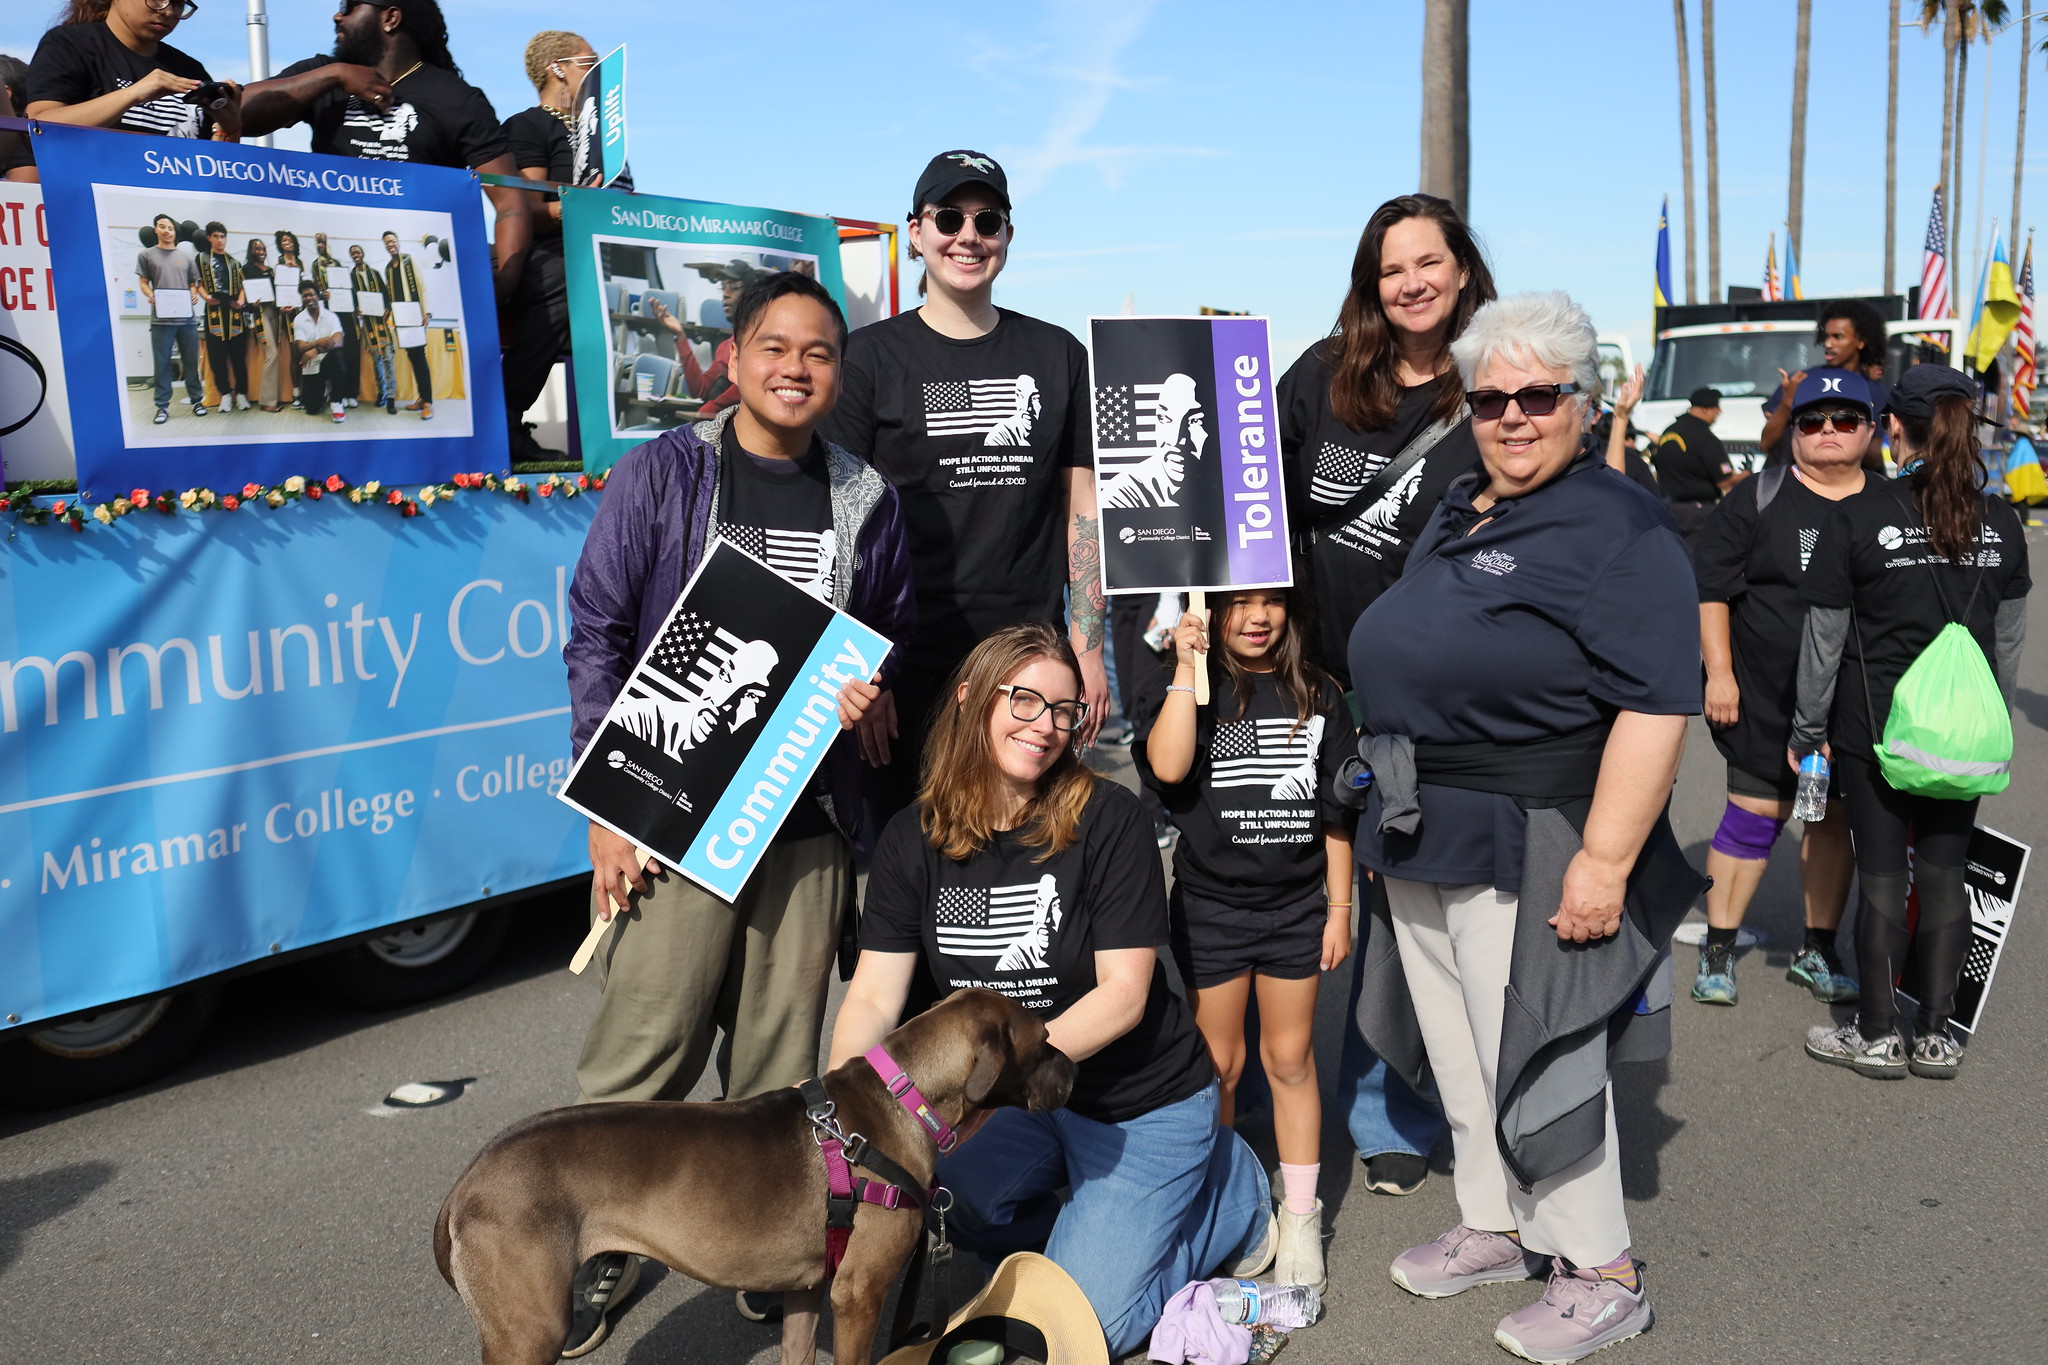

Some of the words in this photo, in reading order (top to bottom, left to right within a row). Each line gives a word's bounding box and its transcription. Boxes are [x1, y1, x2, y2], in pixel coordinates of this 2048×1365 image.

[604, 84, 623, 147] Uplift
[143, 150, 193, 176] SAN
[194, 154, 265, 183] DIEGO
[268, 161, 321, 189] MESA
[321, 169, 404, 197] COLLEGE
[611, 205, 642, 228] SAN
[643, 211, 689, 231] DIEGO
[690, 215, 762, 236] MIRAMAR
[762, 220, 804, 242] COLLEGE
[939, 457, 960, 466] HOPE
[961, 456, 970, 464] IN
[971, 455, 1001, 464] ACTION:
[1001, 455, 1008, 463] A
[1008, 455, 1034, 463] DREAM
[1234, 355, 1273, 549] Tolerance
[956, 465, 976, 475] STILL
[976, 465, 1021, 473] UNFOLDING
[1345, 525, 1382, 547] UNFOLDING
[1376, 530, 1402, 546] DREAM
[1, 592, 422, 734] mmunity
[448, 566, 570, 665] Col
[706, 638, 869, 870] Community
[623, 767, 645, 783] Community
[644, 780, 660, 792] College
[658, 788, 673, 800] District
[626, 760, 642, 773] SAN
[640, 769, 663, 786] DIEGO
[41, 820, 247, 894] Miramar
[264, 788, 416, 843] College
[456, 754, 573, 802] Colleg
[1221, 810, 1246, 819] HOPE
[1246, 810, 1257, 819] IN
[1257, 809, 1291, 818] ACTION:
[1291, 809, 1298, 818] A
[1298, 809, 1316, 818] DRE
[1239, 821, 1263, 830] STILL
[1264, 820, 1311, 829] UNFOLDING
[1231, 834, 1260, 844] Carried
[1260, 833, 1288, 846] forward
[949, 979, 973, 988] HOPE
[972, 980, 983, 988] IN
[1017, 980, 1025, 988] A
[1025, 977, 1059, 987] DREAM
[998, 988, 1042, 998] FOLDING
[1027, 999, 1054, 1009] SDCCD
